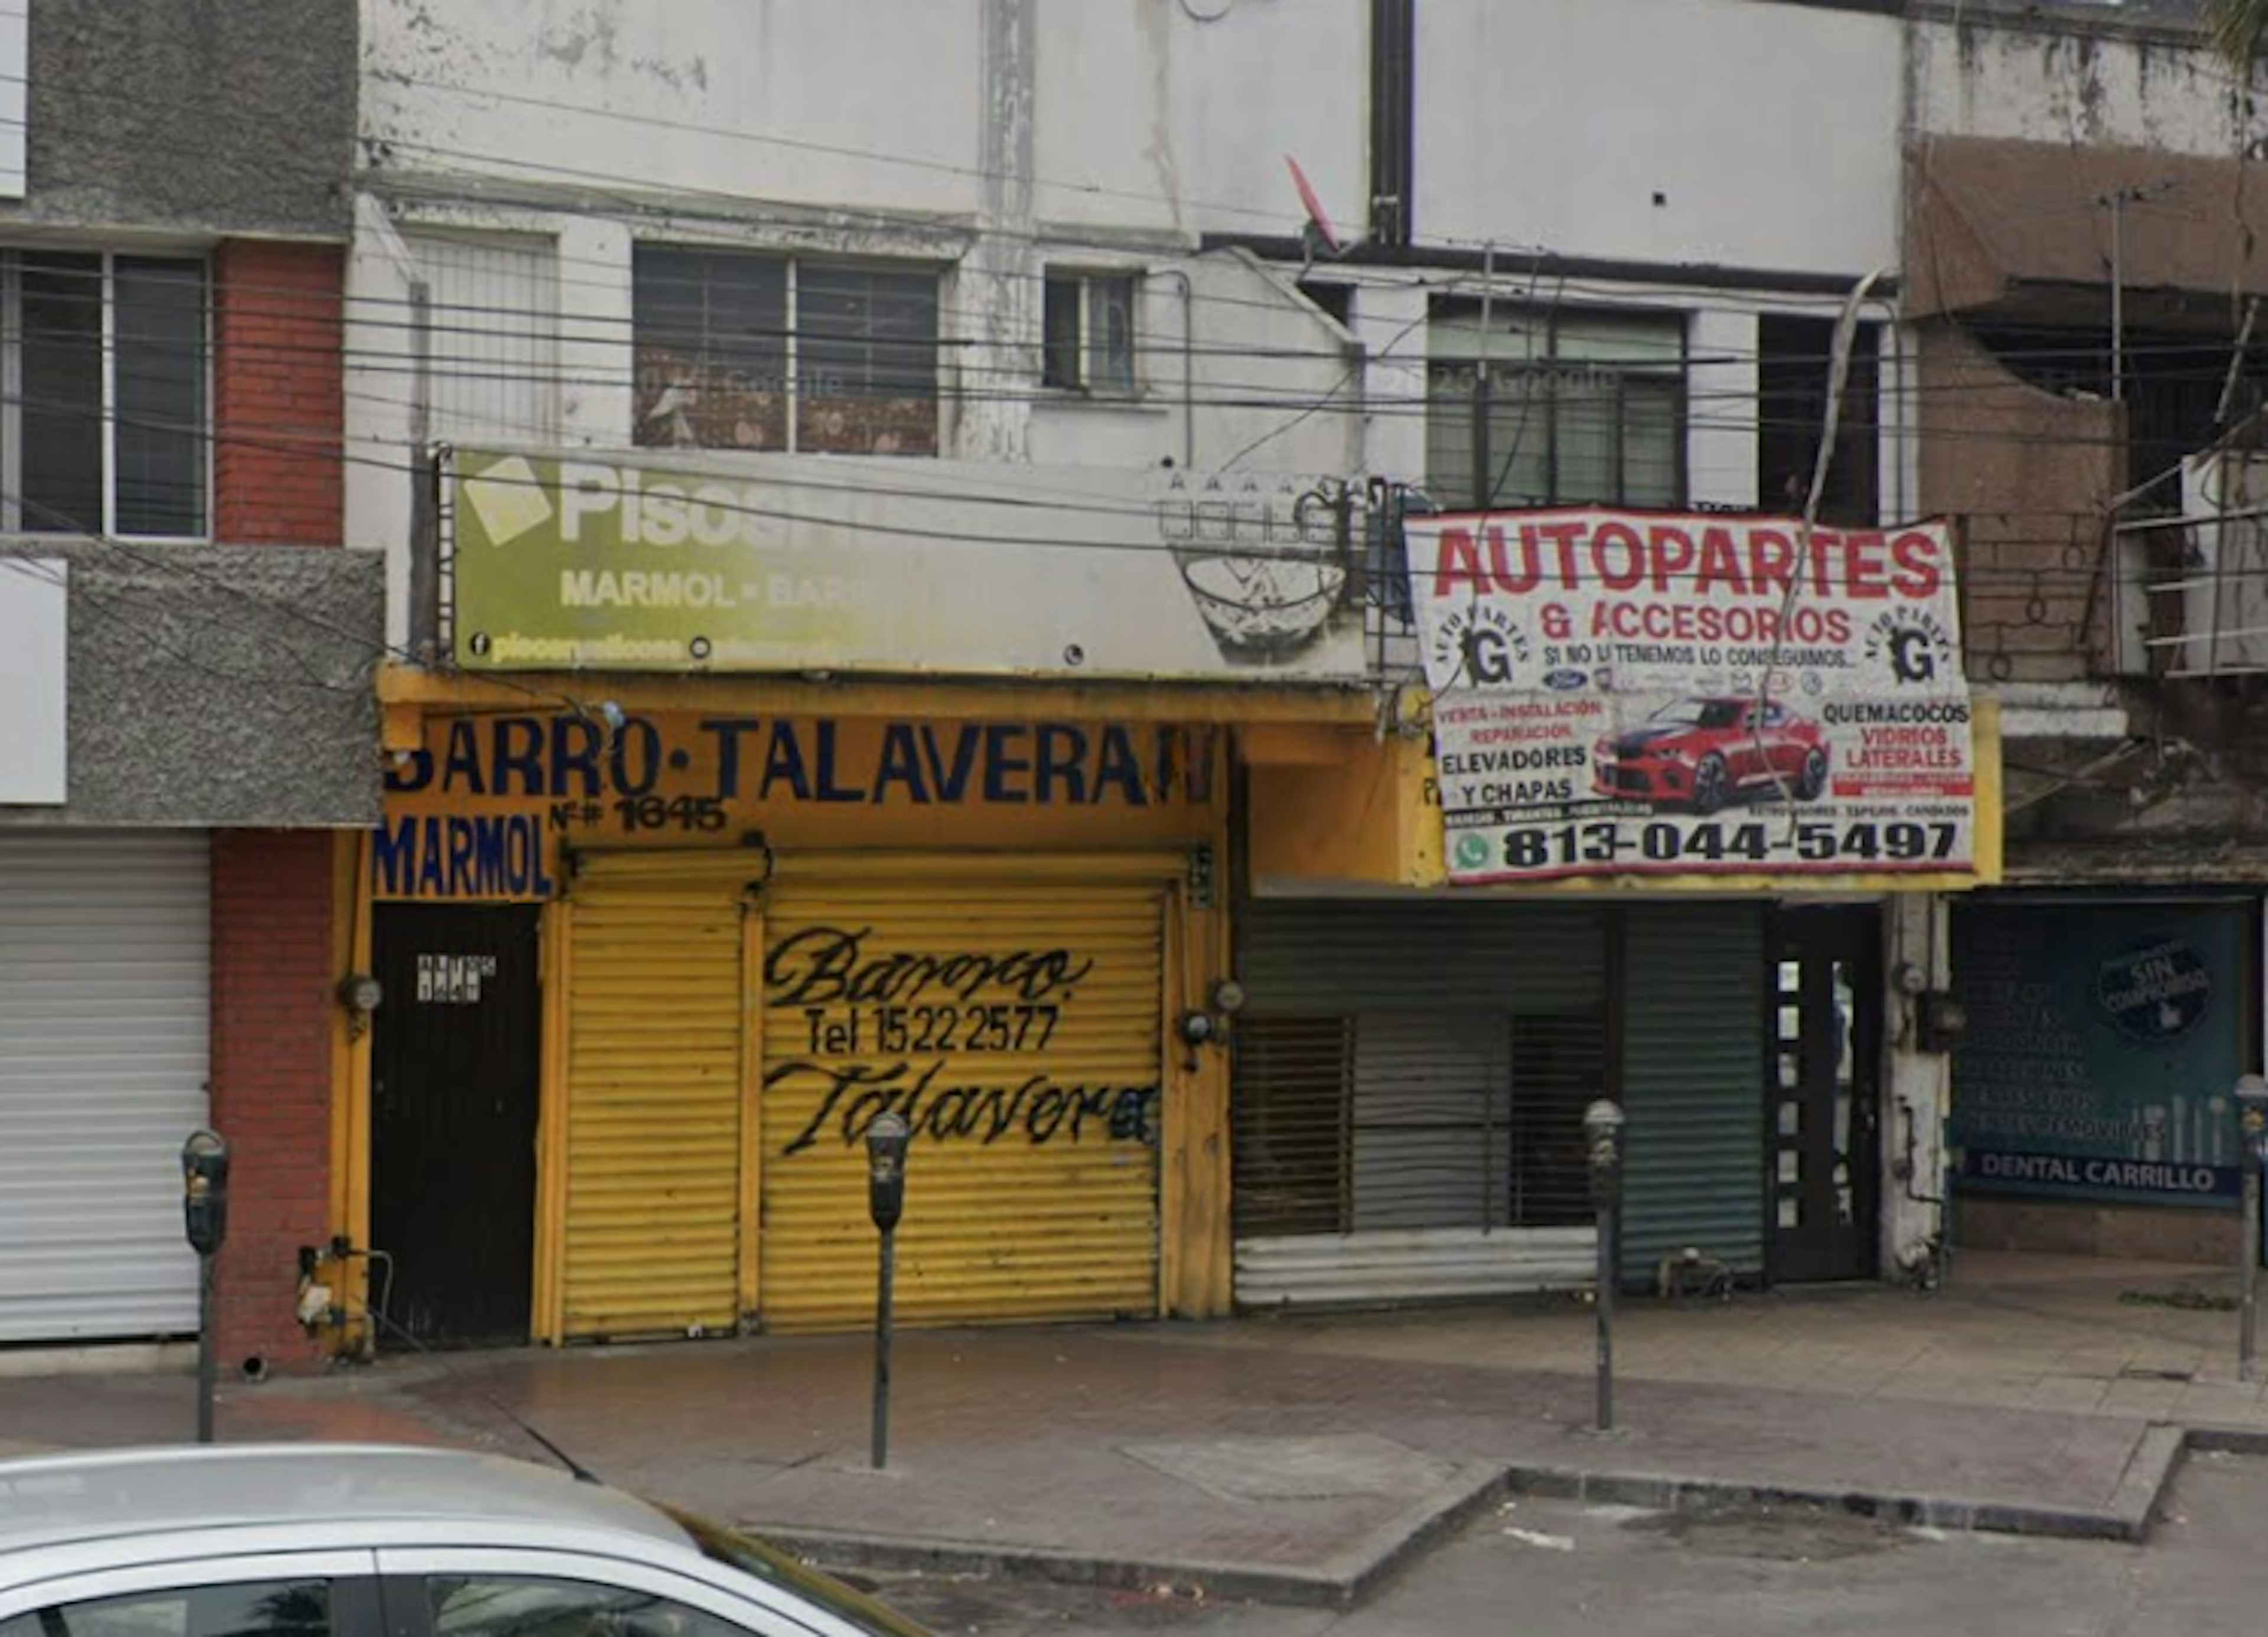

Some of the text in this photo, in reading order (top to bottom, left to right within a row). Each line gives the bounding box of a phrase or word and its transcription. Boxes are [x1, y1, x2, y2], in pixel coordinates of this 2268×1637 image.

[1433, 521, 1942, 600] AUTOPARTES
[560, 569, 735, 608] MARMOL
[1540, 603, 1572, 640] &
[1566, 643, 1592, 663] NO
[1615, 644, 1695, 665] TENEMOS
[1824, 704, 1969, 724] QUEMACOCOS
[1861, 727, 1947, 744] VIDRIOS
[700, 719, 1148, 805] TALAVERA
[1442, 745, 1586, 774] ELEVADORES
[1846, 748, 1962, 767] LATERALES
[1461, 786, 1475, 804] Y
[1481, 778, 1573, 803] CHAPAS
[614, 795, 726, 832] 1645
[372, 814, 555, 897] MARMOL
[1504, 822, 1956, 867] 813-044-5497
[806, 1007, 860, 1054] Tel
[1981, 1152, 2215, 1192] DENTAL CARRILLO
